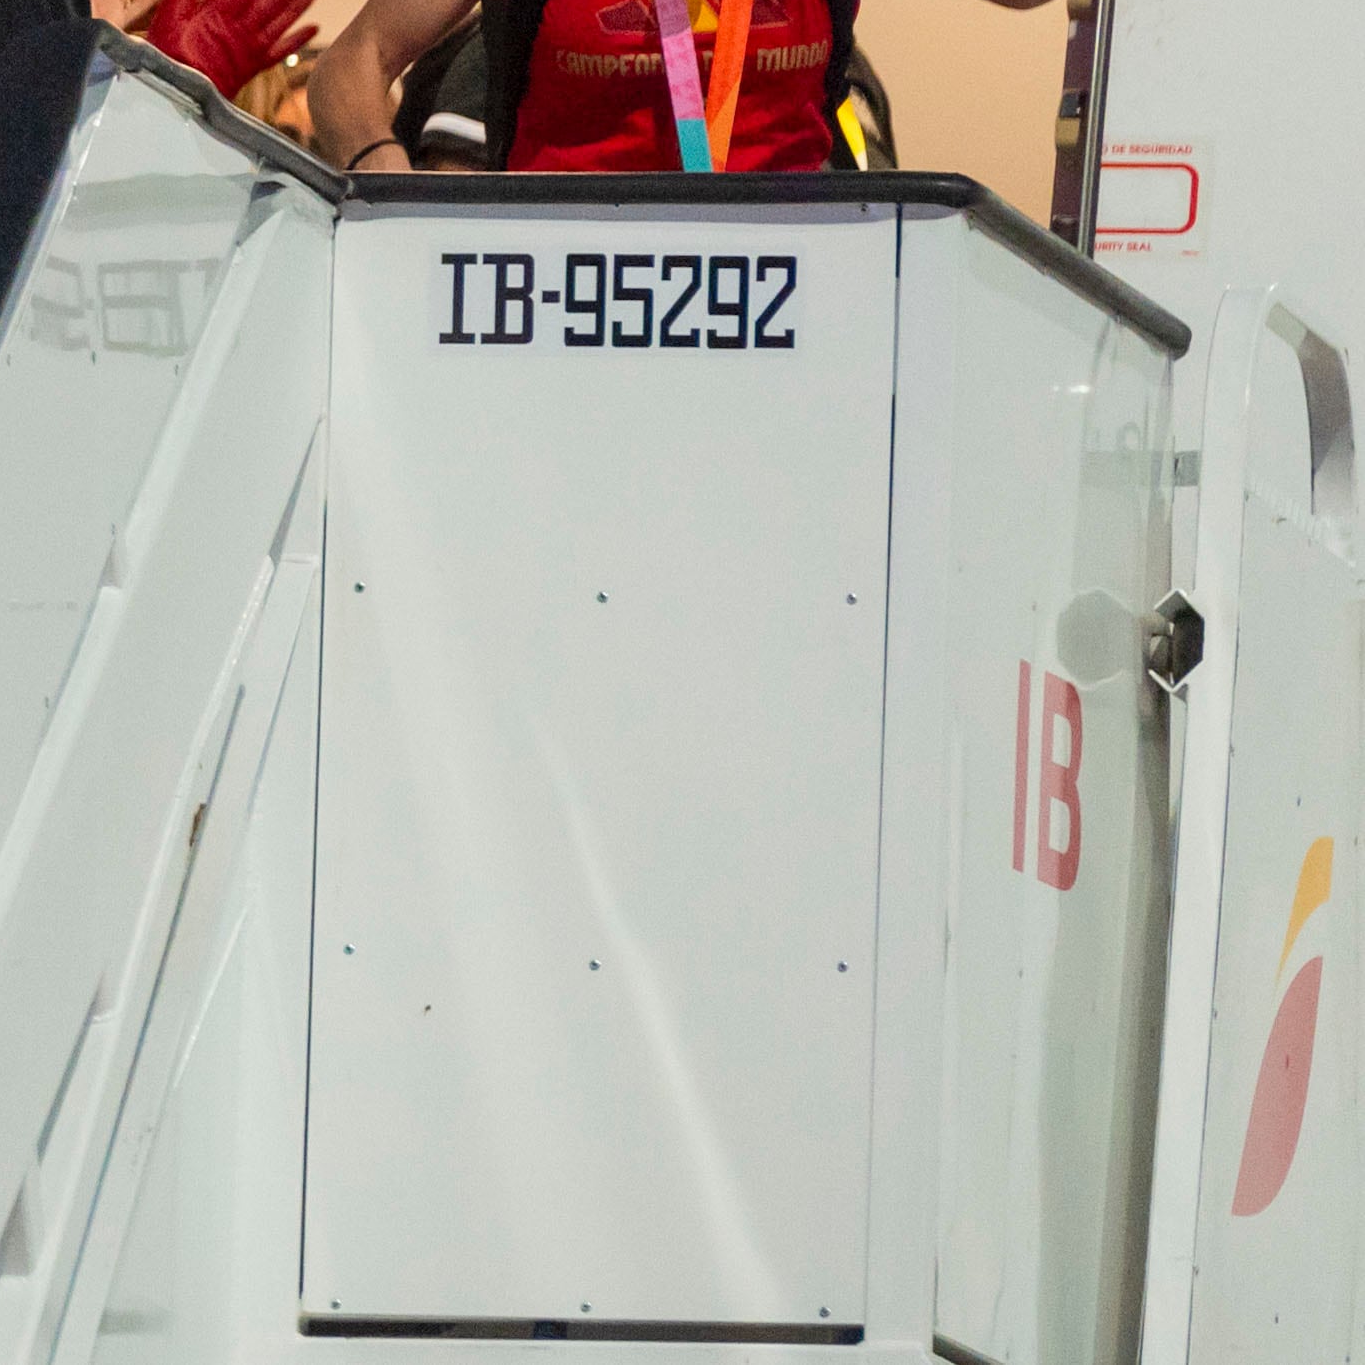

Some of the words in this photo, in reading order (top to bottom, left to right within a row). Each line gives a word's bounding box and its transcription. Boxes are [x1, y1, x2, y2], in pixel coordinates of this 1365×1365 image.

[1127, 241, 1153, 252] SEAL
[438, 252, 798, 350] IB-95292
[1011, 657, 1083, 892] IB
